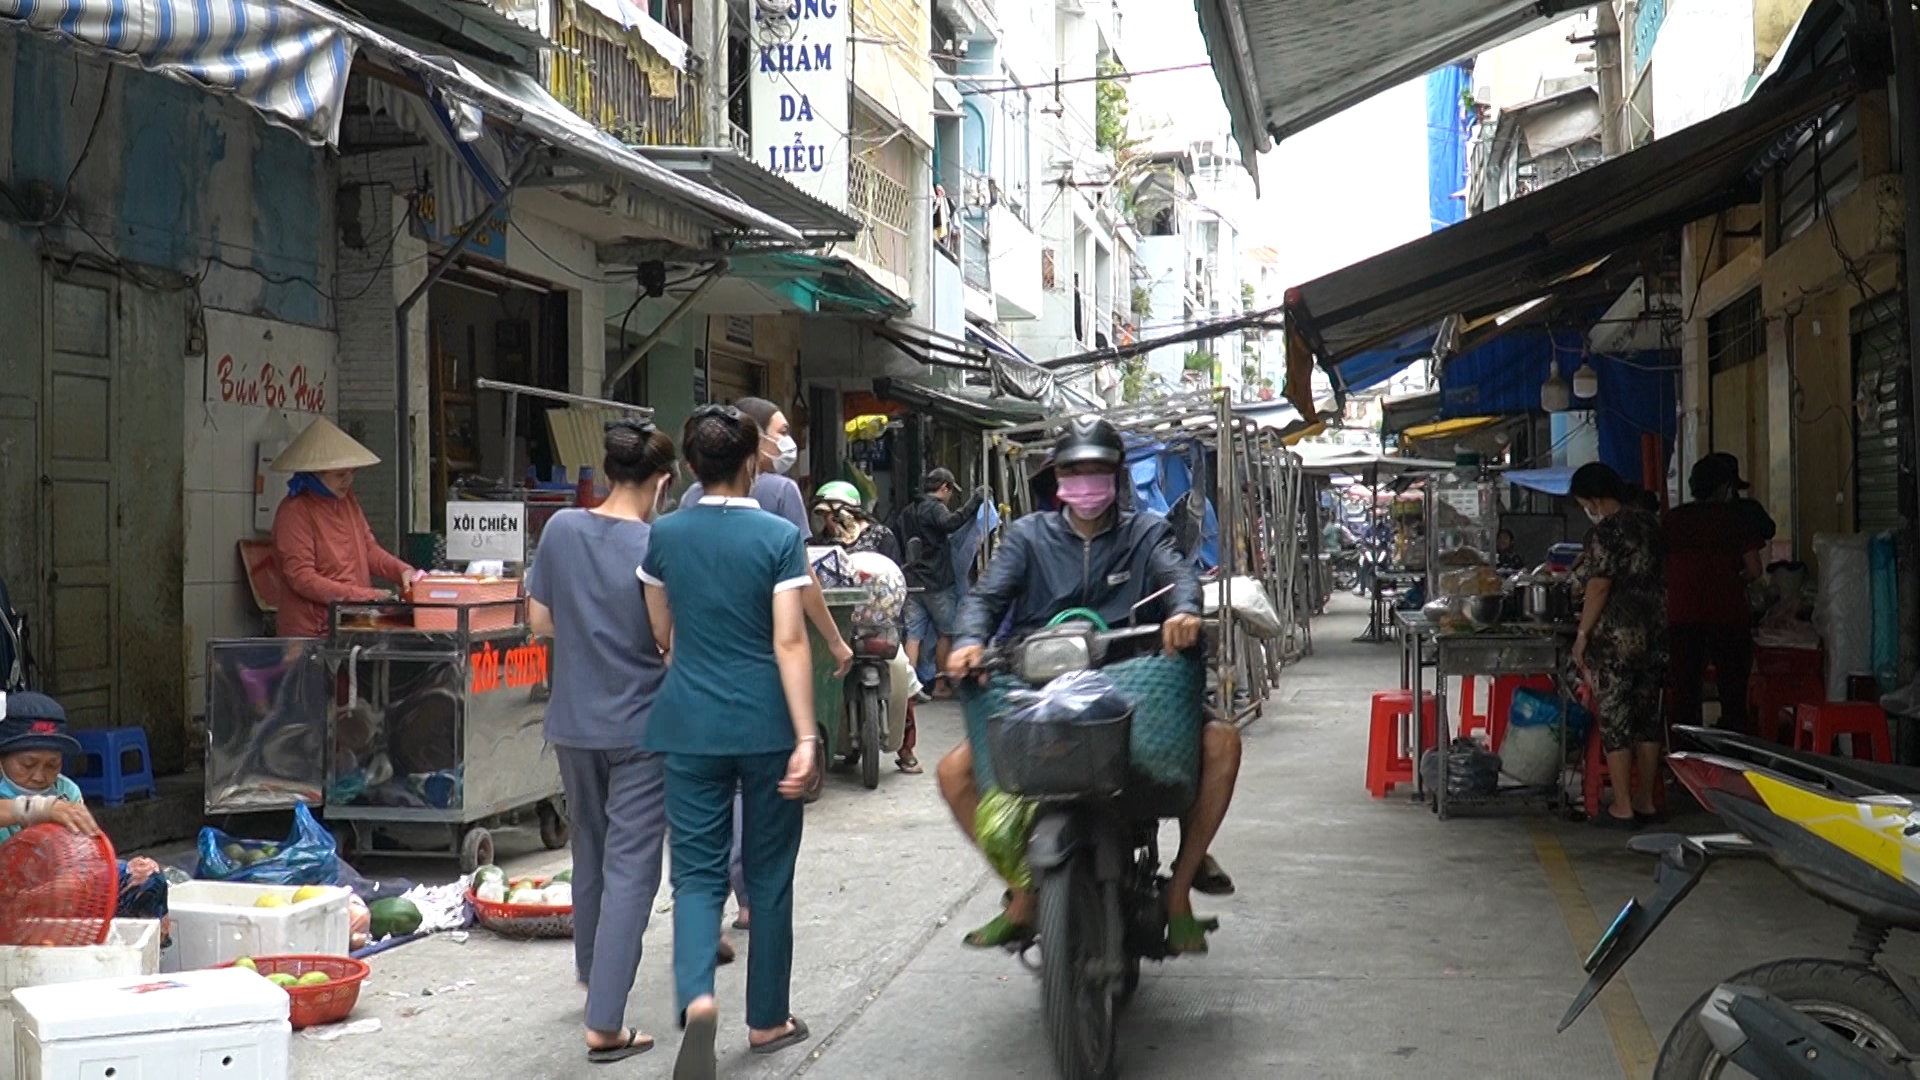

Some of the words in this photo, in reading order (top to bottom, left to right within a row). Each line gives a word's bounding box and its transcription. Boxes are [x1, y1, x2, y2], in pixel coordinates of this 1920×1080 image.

[759, 34, 832, 72] KHÁM
[779, 94, 814, 122] DA
[768, 131, 825, 172] LIỄU
[217, 353, 259, 404] Bún
[261, 362, 287, 408] Bò
[290, 365, 327, 413] Huế
[453, 514, 474, 531] XÔI
[479, 513, 517, 532] CHIÊN
[471, 641, 500, 693] XÔI
